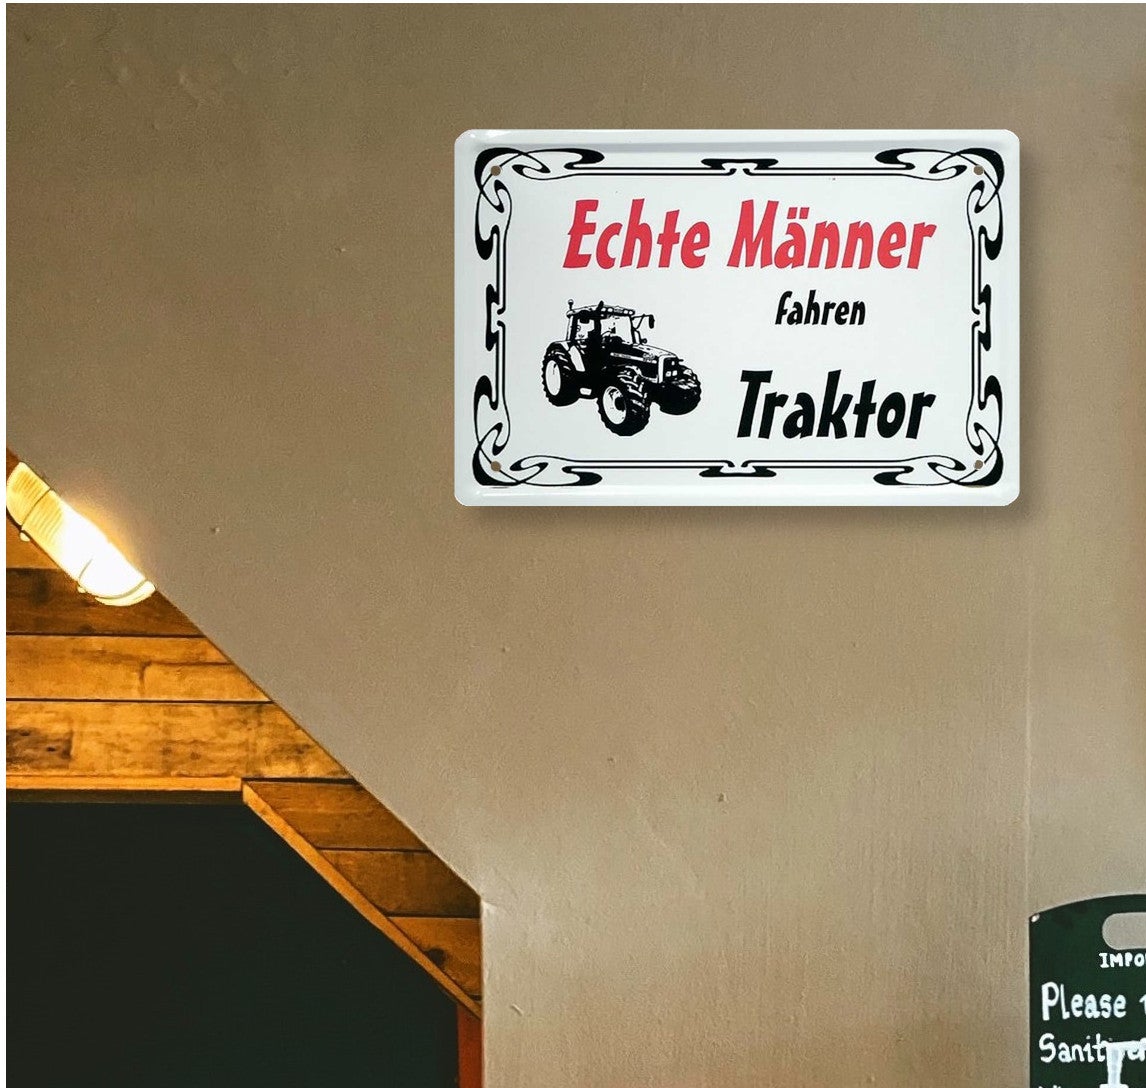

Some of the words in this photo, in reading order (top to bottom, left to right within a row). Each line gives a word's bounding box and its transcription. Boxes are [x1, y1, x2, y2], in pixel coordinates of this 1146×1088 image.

[563, 199, 711, 270] Echte
[727, 200, 937, 270] Männer
[774, 290, 866, 326] fahren
[736, 369, 937, 440] Traktor
[1041, 981, 1127, 1021] Please
